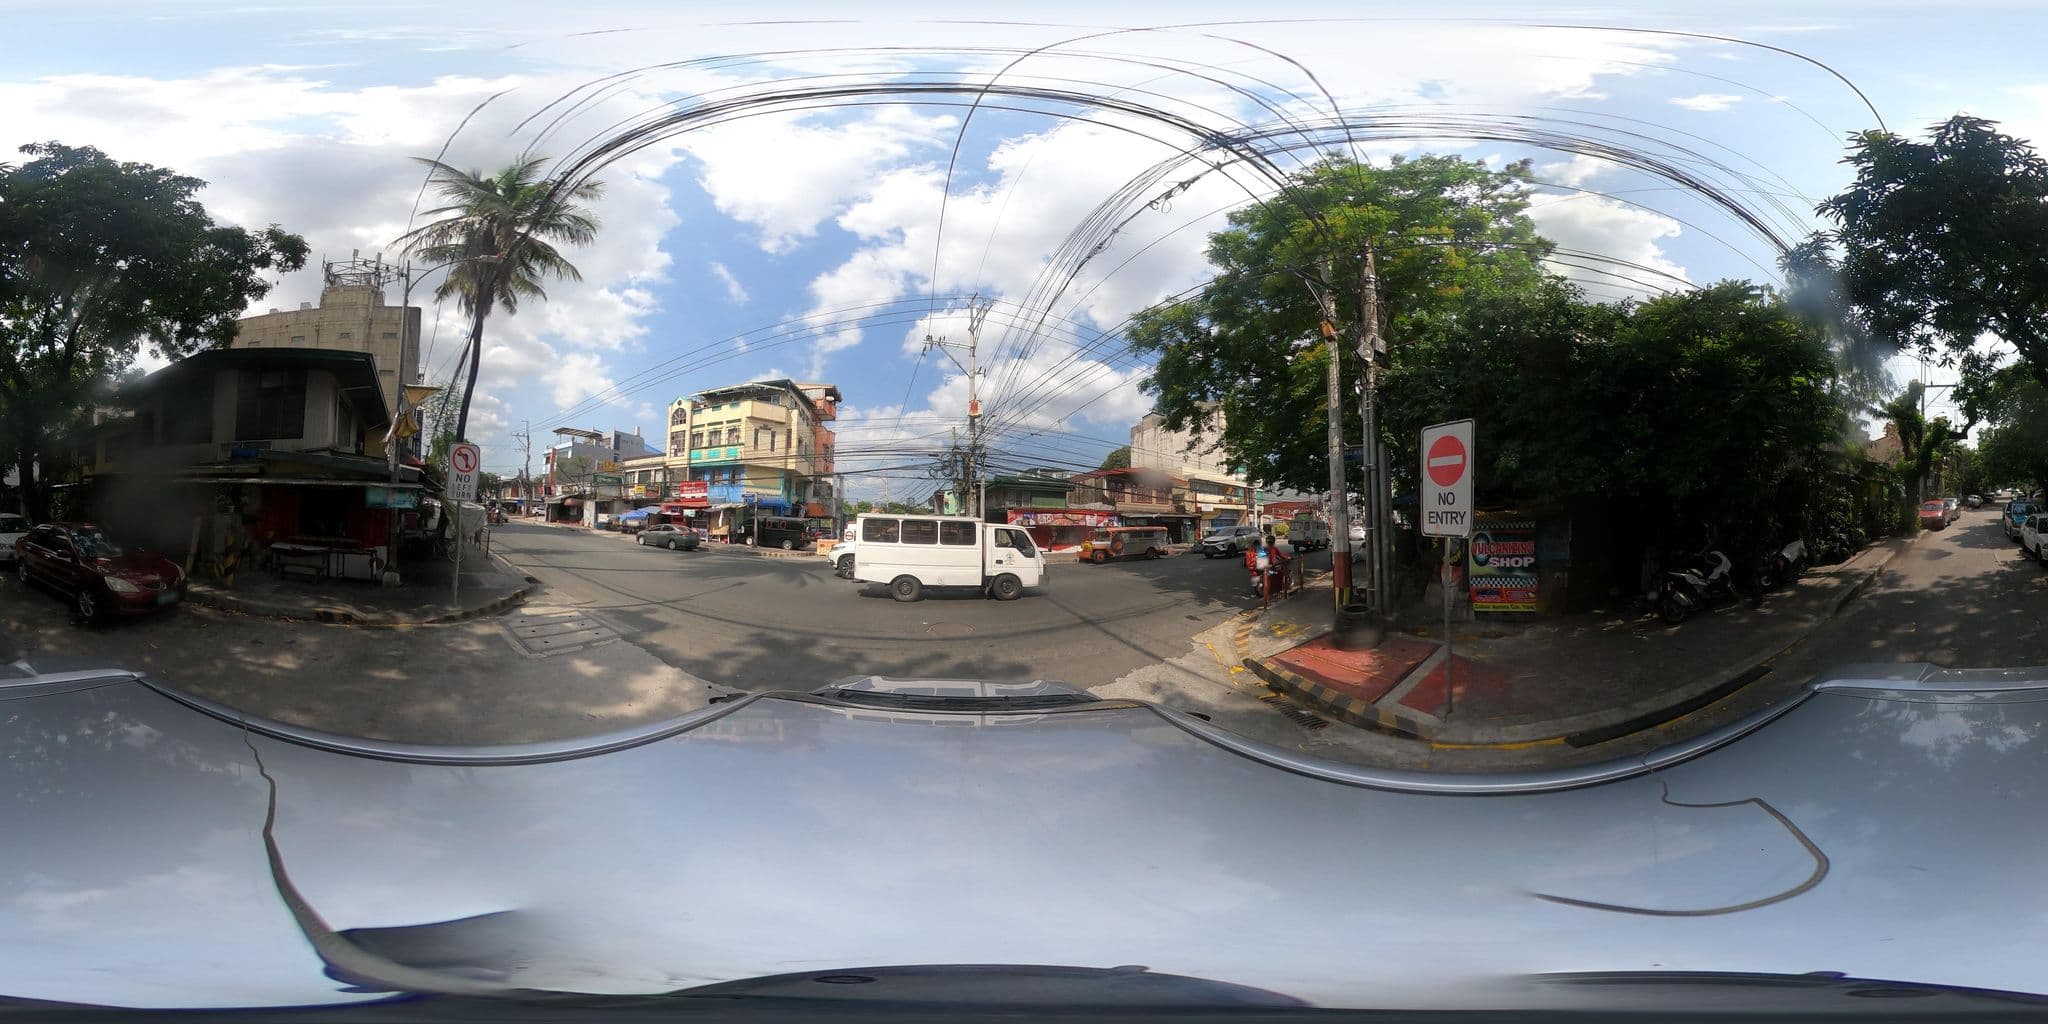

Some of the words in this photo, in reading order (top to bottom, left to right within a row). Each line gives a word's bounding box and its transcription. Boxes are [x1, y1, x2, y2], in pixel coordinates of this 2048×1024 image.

[455, 473, 471, 483] NO
[1438, 492, 1455, 505] NO
[1428, 511, 1467, 525] ENTRY
[1488, 556, 1536, 568] SHOP
